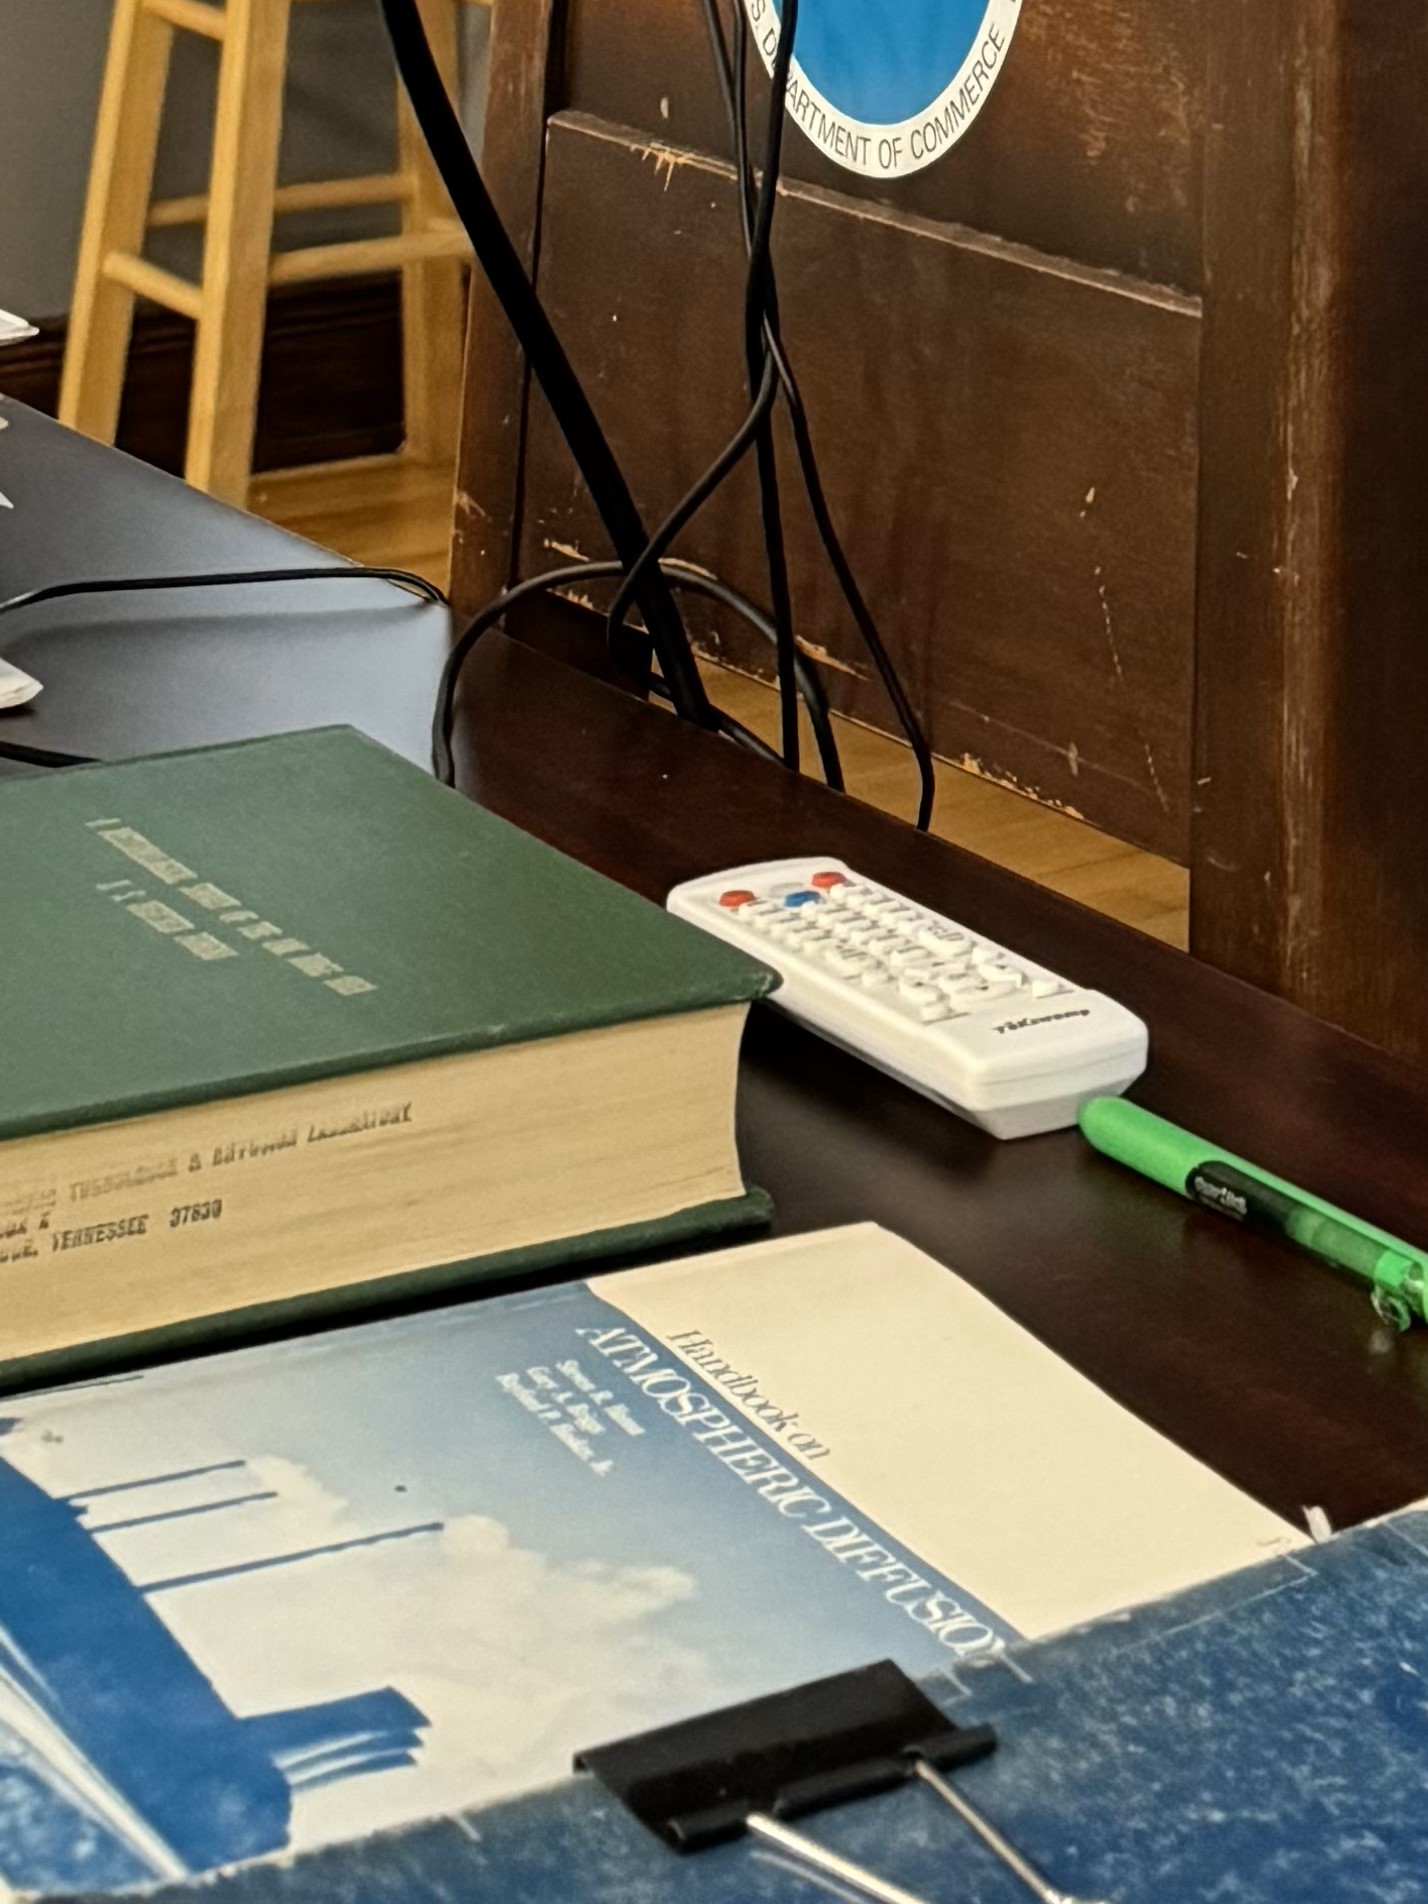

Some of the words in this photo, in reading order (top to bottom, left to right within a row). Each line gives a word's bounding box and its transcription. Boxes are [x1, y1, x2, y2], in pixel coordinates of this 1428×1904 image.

[763, 27, 872, 166] DARTMENT
[878, 135, 903, 170] OF
[910, 23, 1006, 161] COMMERCE
[575, 1327, 833, 1518] ATMOSPHERIC
[665, 1329, 800, 1433] Handbook
[787, 1432, 832, 1462] on
